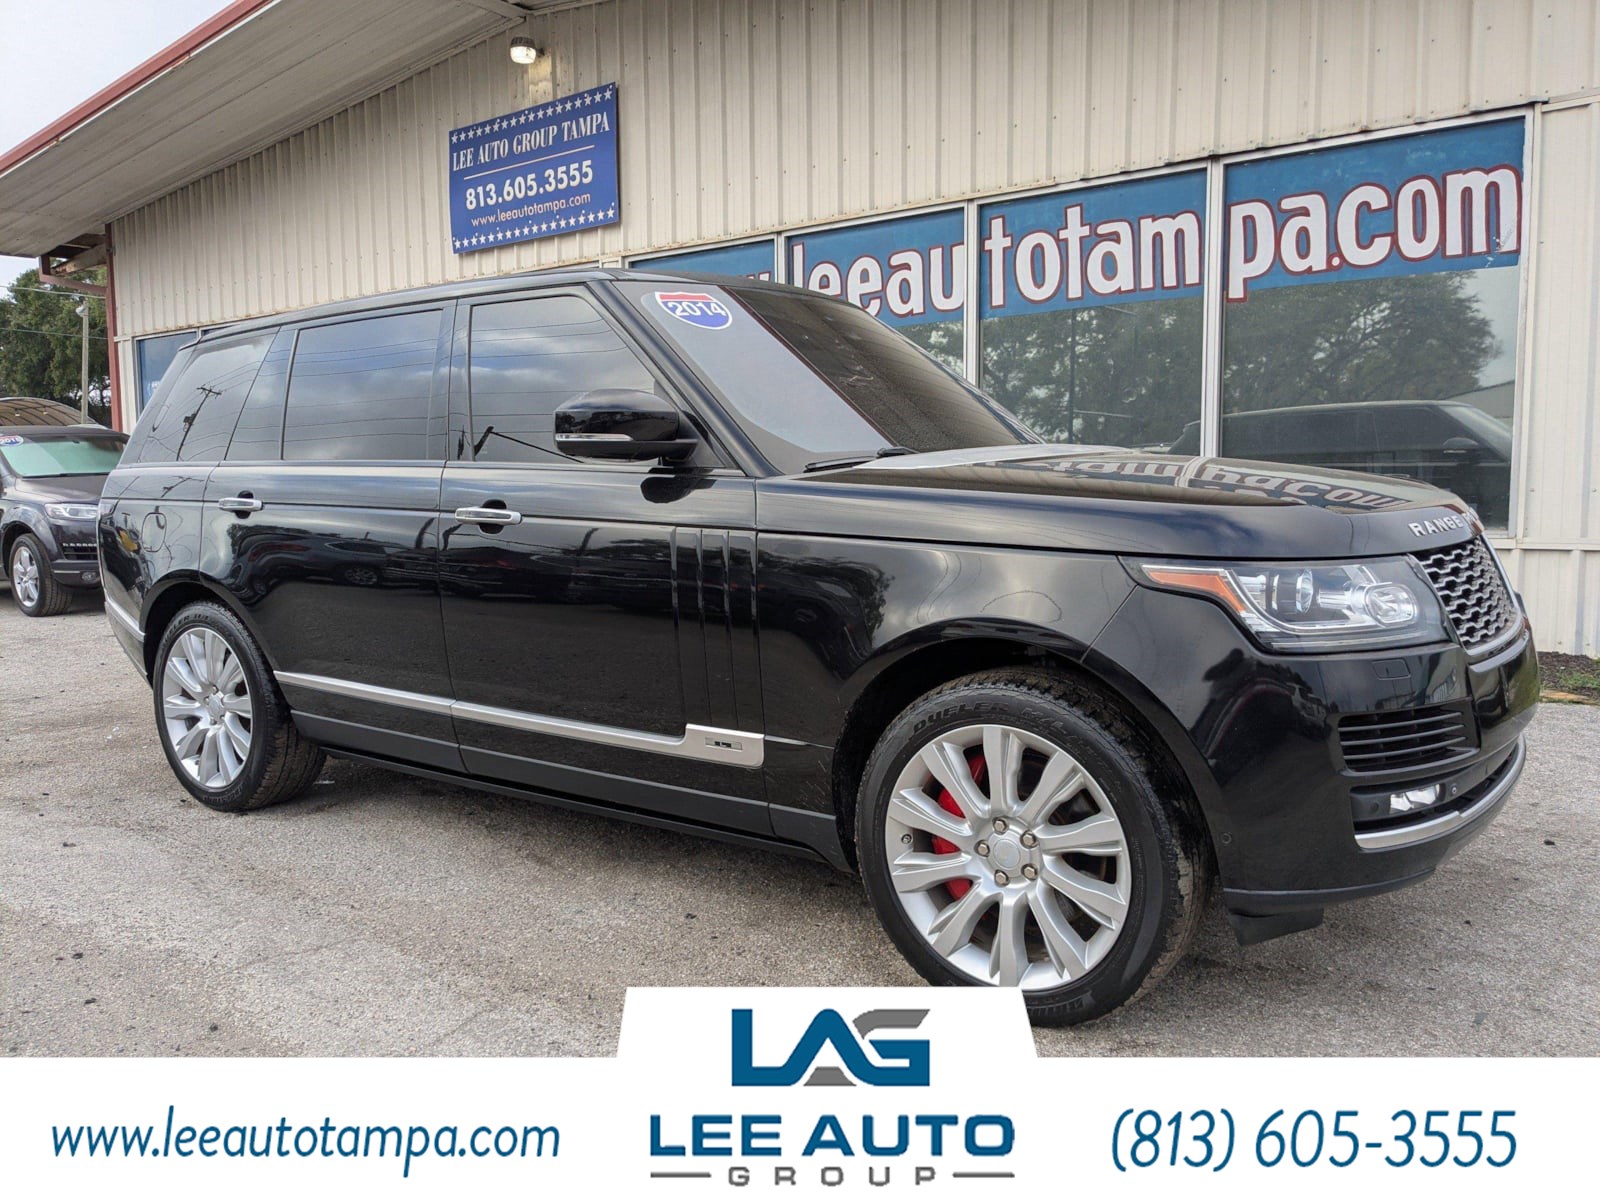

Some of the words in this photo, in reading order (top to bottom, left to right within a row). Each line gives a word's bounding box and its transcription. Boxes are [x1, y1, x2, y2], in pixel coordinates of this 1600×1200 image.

[452, 147, 474, 172] LEE
[477, 138, 509, 162] AUTO
[512, 126, 558, 155] GROUP
[562, 111, 610, 142] TAMPA
[465, 159, 593, 210] 813.605.3555
[471, 193, 591, 227] www.leeautotampa.com
[667, 301, 727, 316] 2014
[1408, 515, 1464, 537] RANGE
